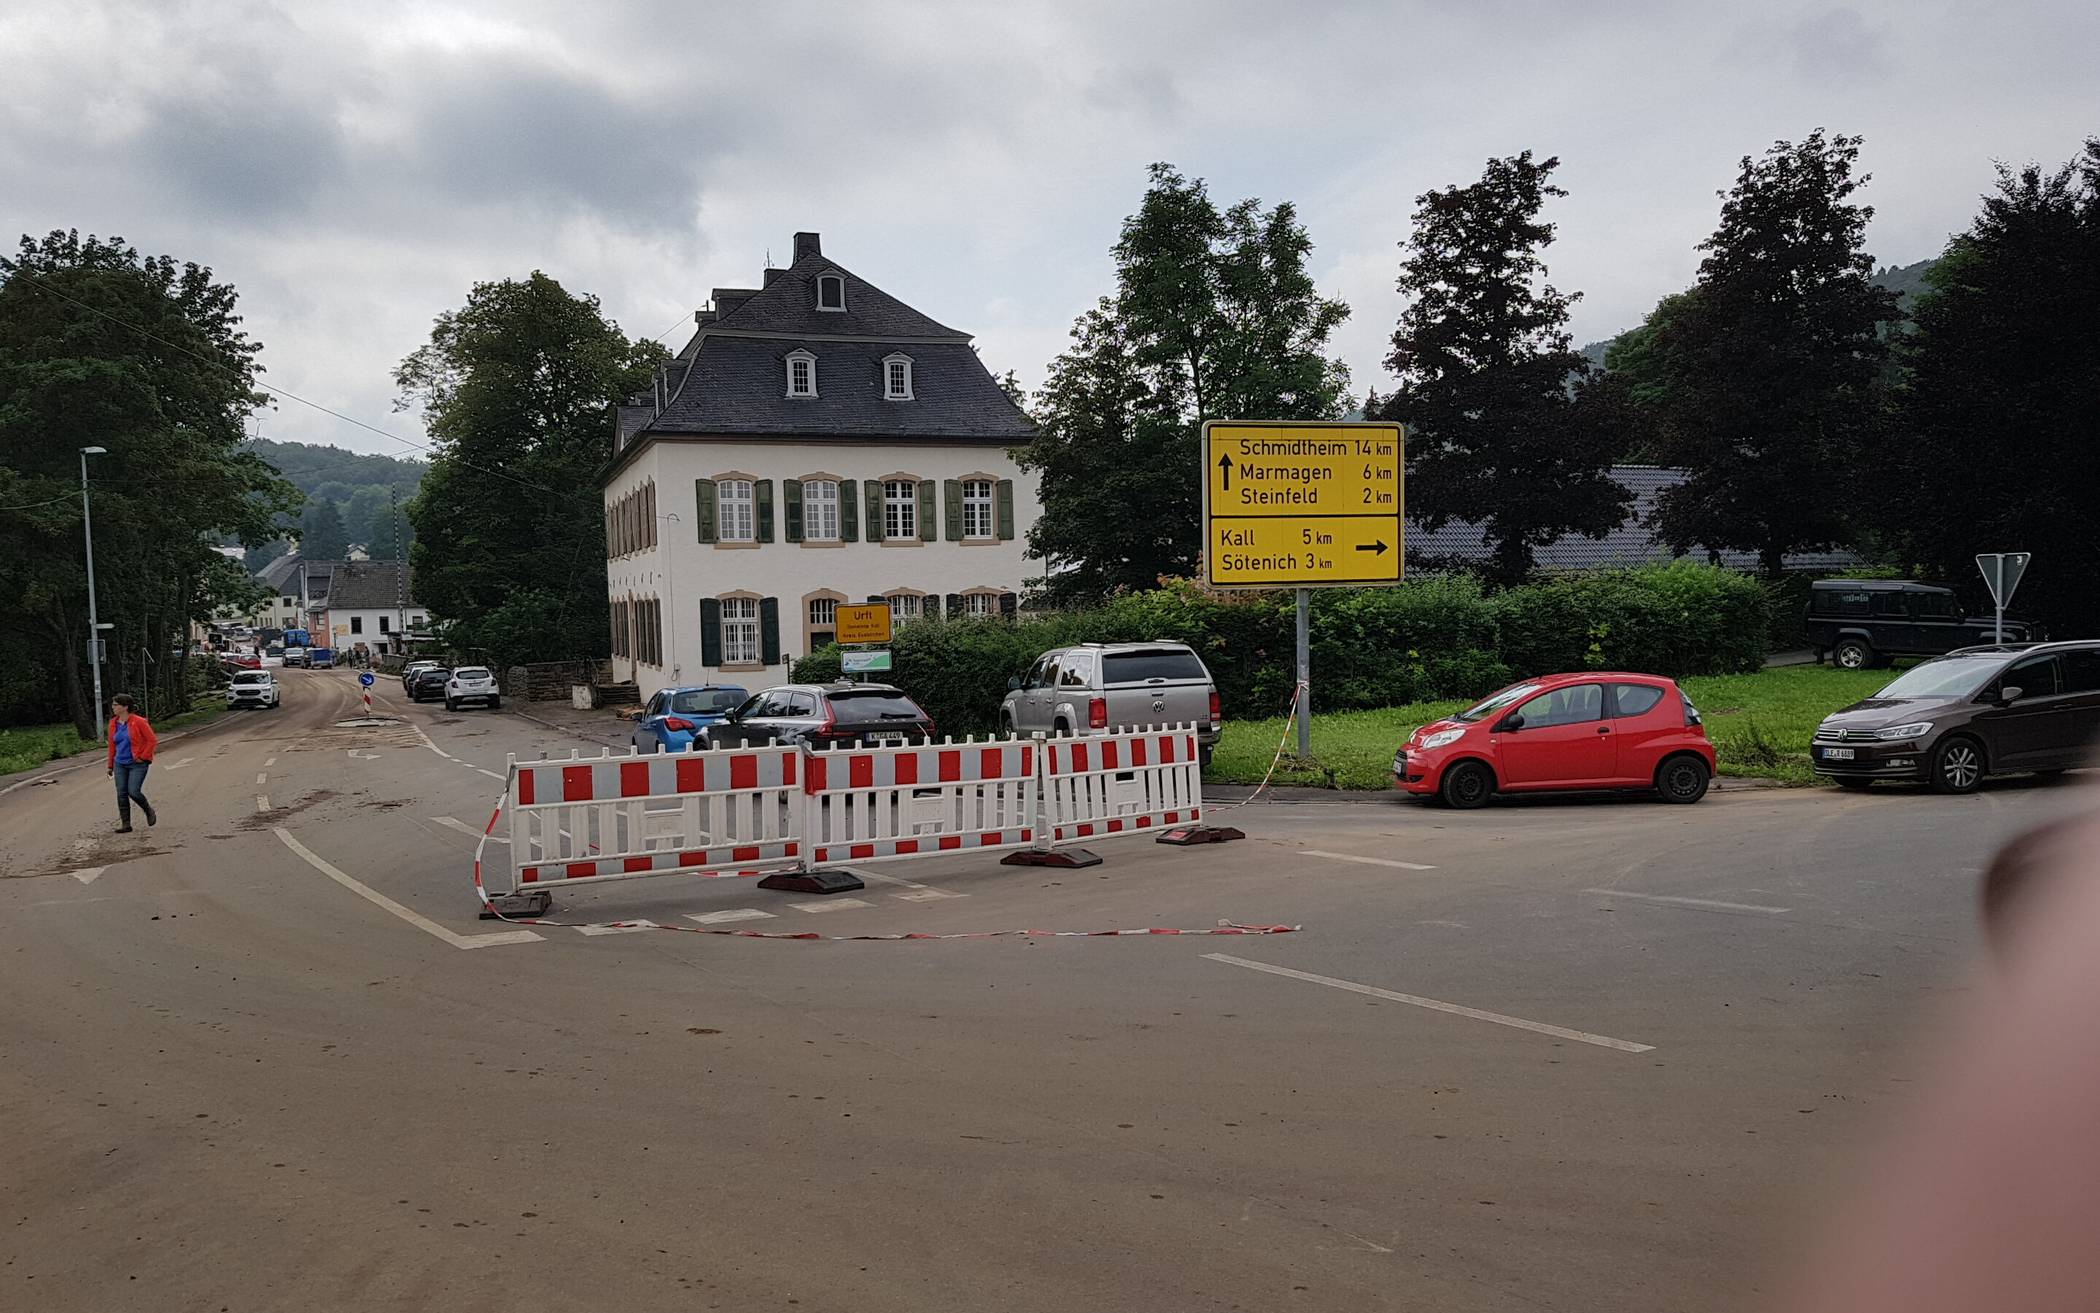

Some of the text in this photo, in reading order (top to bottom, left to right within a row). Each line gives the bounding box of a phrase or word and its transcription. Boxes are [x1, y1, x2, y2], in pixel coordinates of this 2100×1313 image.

[1240, 439, 1392, 456] Schmidtheim 14 km
[1240, 464, 1392, 484] Marmagen 6 km
[1241, 488, 1392, 504] Steinfeld 2 km
[1221, 529, 1332, 546] Kall 5 km
[1222, 553, 1332, 570] Sötenich 3 km
[854, 611, 873, 620] Urft
